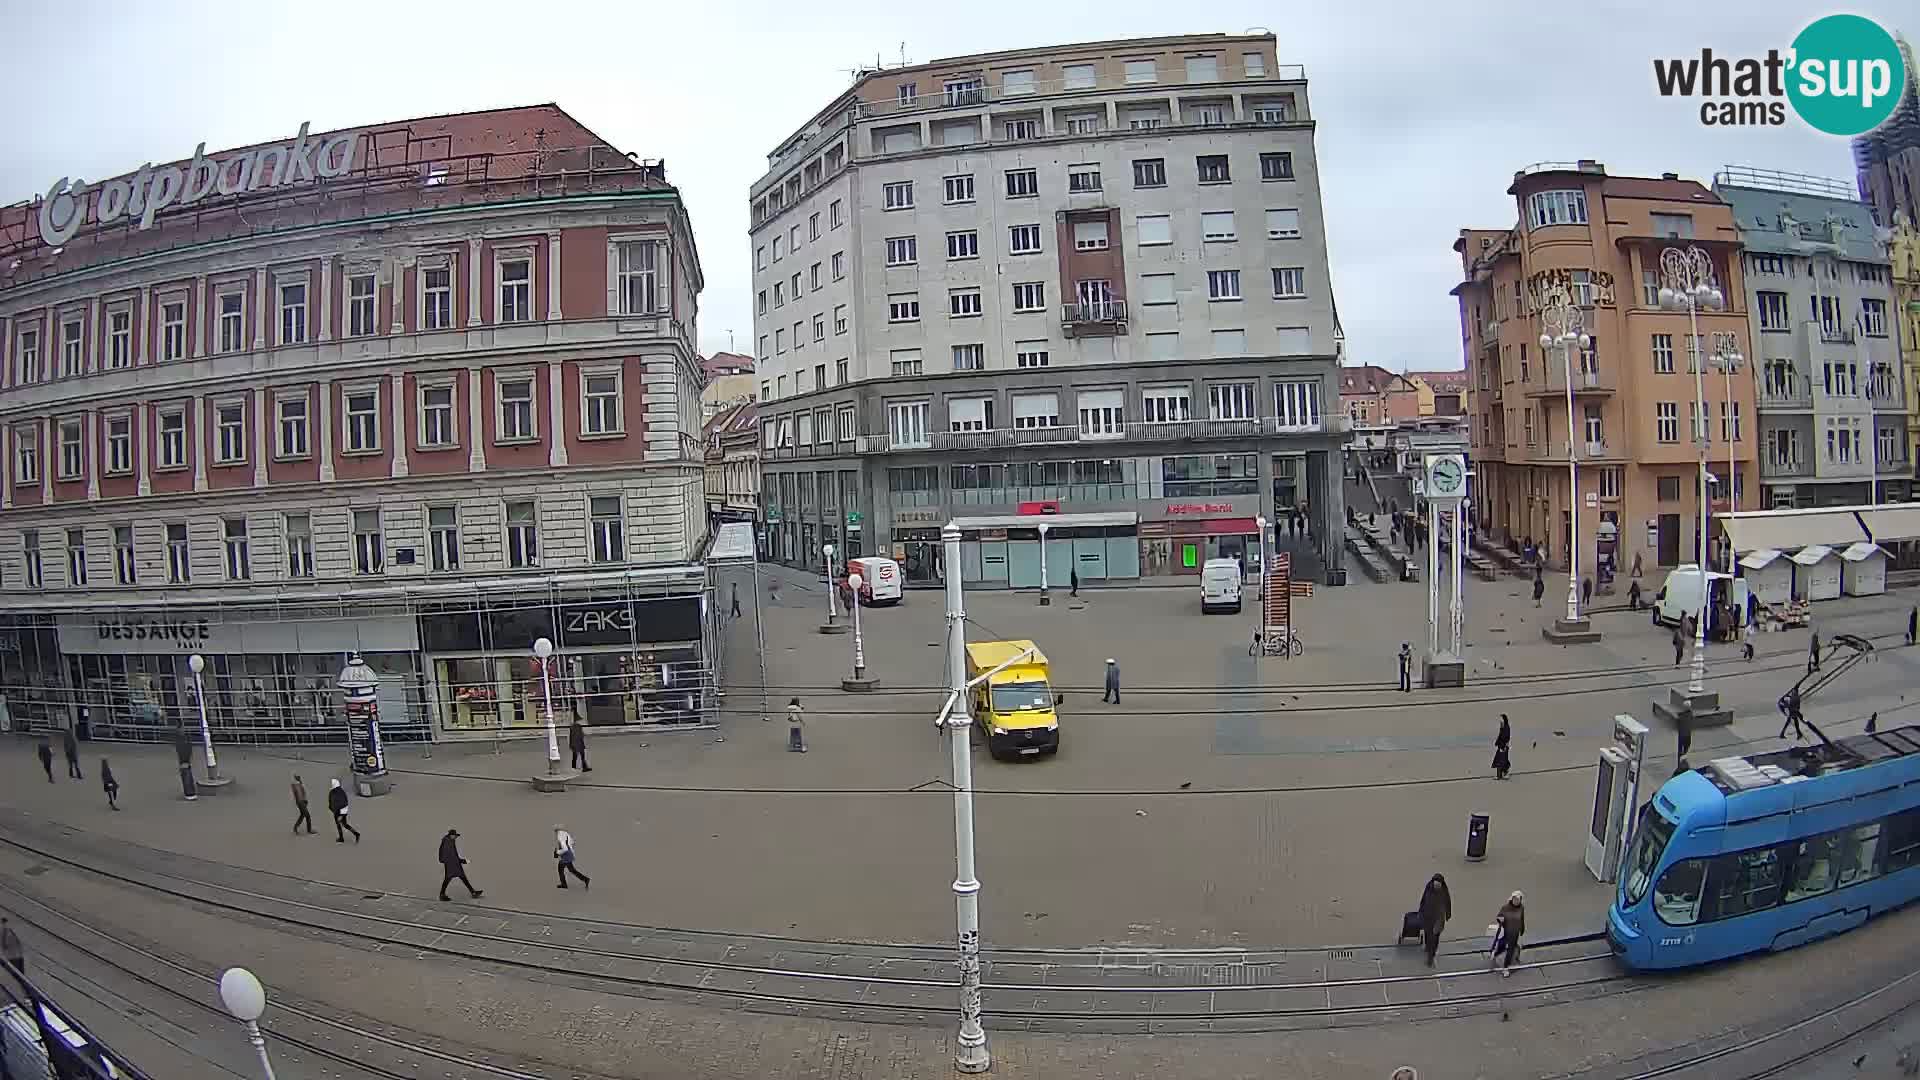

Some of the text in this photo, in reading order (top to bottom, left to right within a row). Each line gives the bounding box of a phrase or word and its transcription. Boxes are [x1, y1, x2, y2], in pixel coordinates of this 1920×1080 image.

[99, 120, 362, 230] otp banka
[98, 618, 209, 641] DESSANGE
[566, 609, 637, 632] ZAKS
